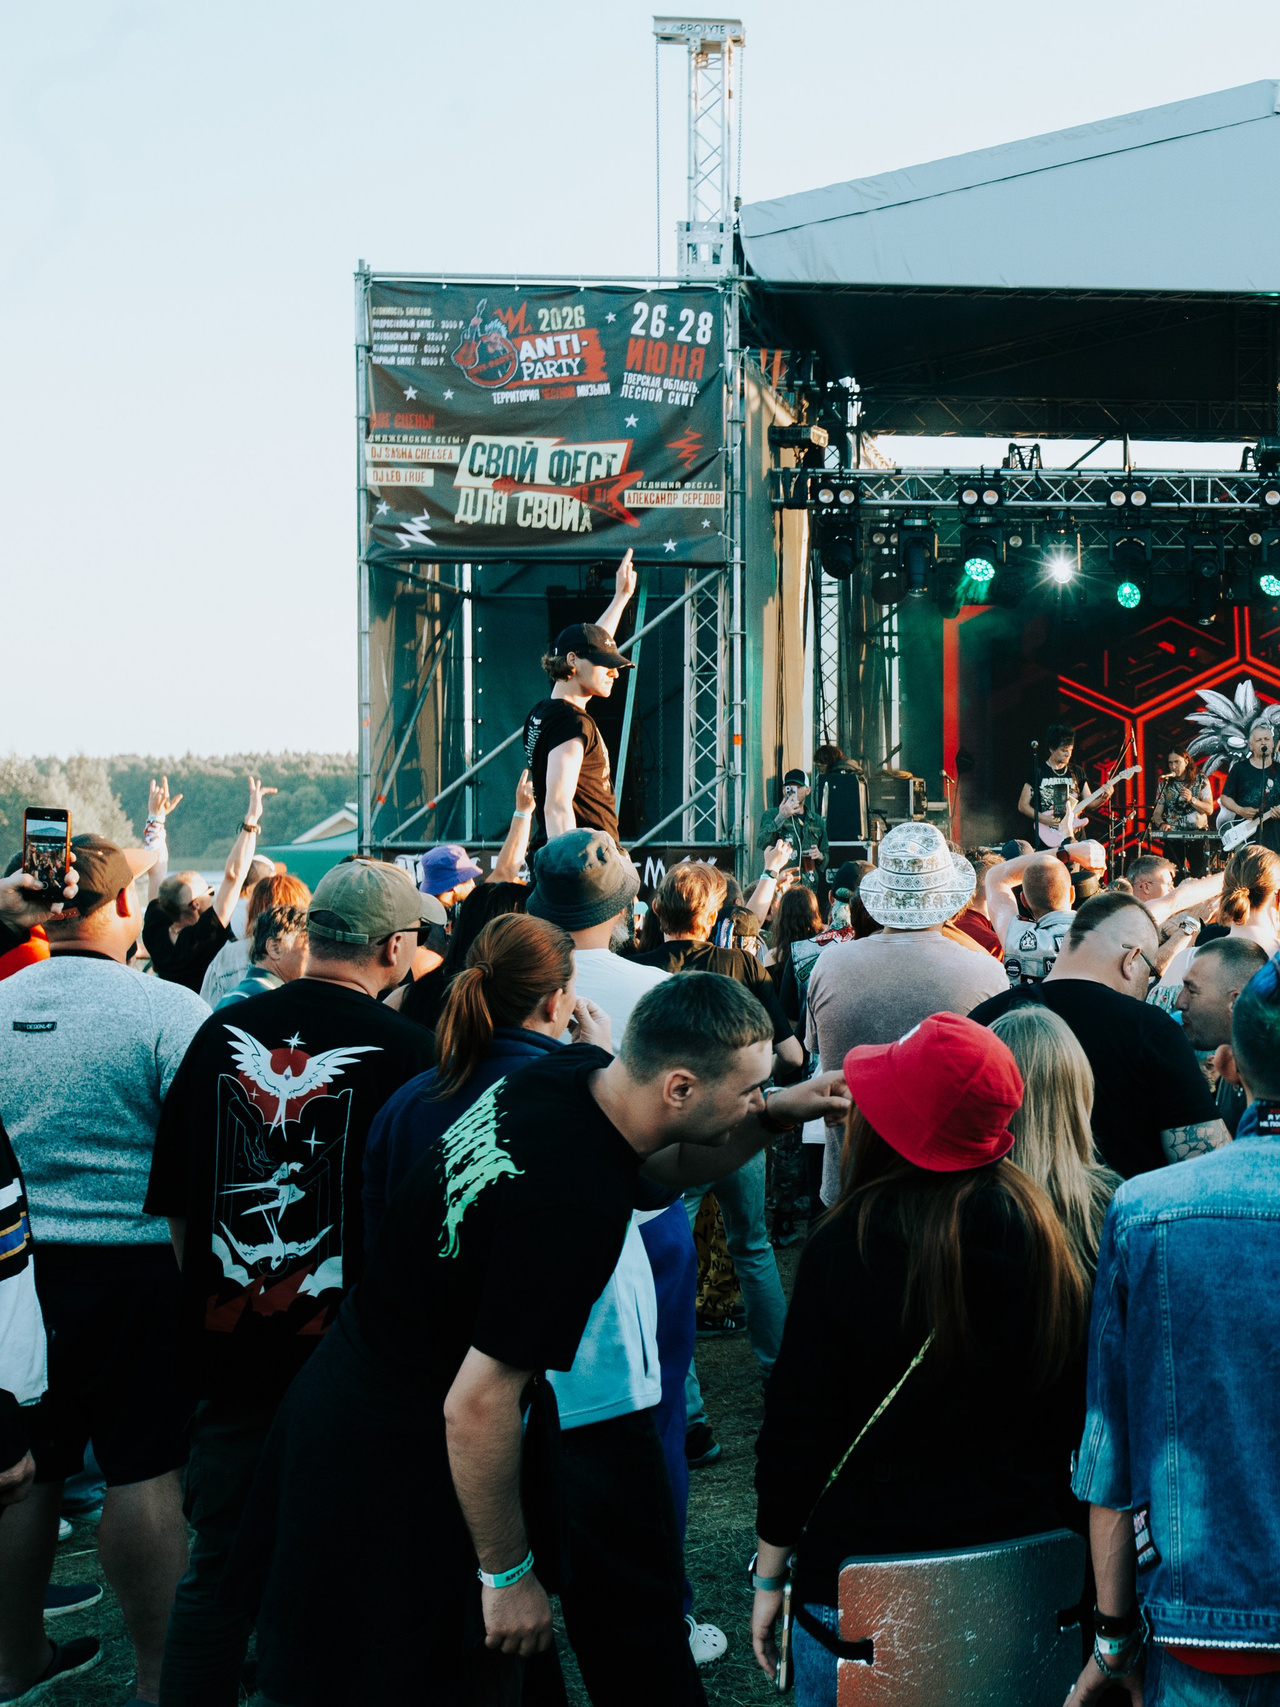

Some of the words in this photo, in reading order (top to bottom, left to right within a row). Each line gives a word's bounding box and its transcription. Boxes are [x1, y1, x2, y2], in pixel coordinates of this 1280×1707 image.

[537, 305, 586, 332] 2026
[630, 302, 714, 345] 26-28
[520, 358, 581, 382] PARTY
[625, 337, 706, 380] ИЮНЯ
[623, 372, 661, 389] ТВЕРСКАЯ
[491, 389, 540, 405] ТЕРРИТОРИЯ
[576, 383, 611, 398] МУЗЫКИ
[620, 384, 663, 403] ЛЕСНОЙ
[667, 391, 696, 408] СКИТ
[371, 447, 382, 459] DJ
[385, 447, 412, 459] SASHA
[415, 448, 453, 460] CHELSEA
[468, 441, 539, 484] СВОЙ
[548, 450, 618, 487] ФЕСТ
[372, 470, 384, 483] DJ
[386, 471, 401, 483] LEO
[404, 471, 425, 483] TRUE
[636, 481, 681, 490] ВЕДУЩИЙ
[454, 488, 507, 525] ДЛЯ
[626, 492, 679, 506] АЛЕКСАНДР
